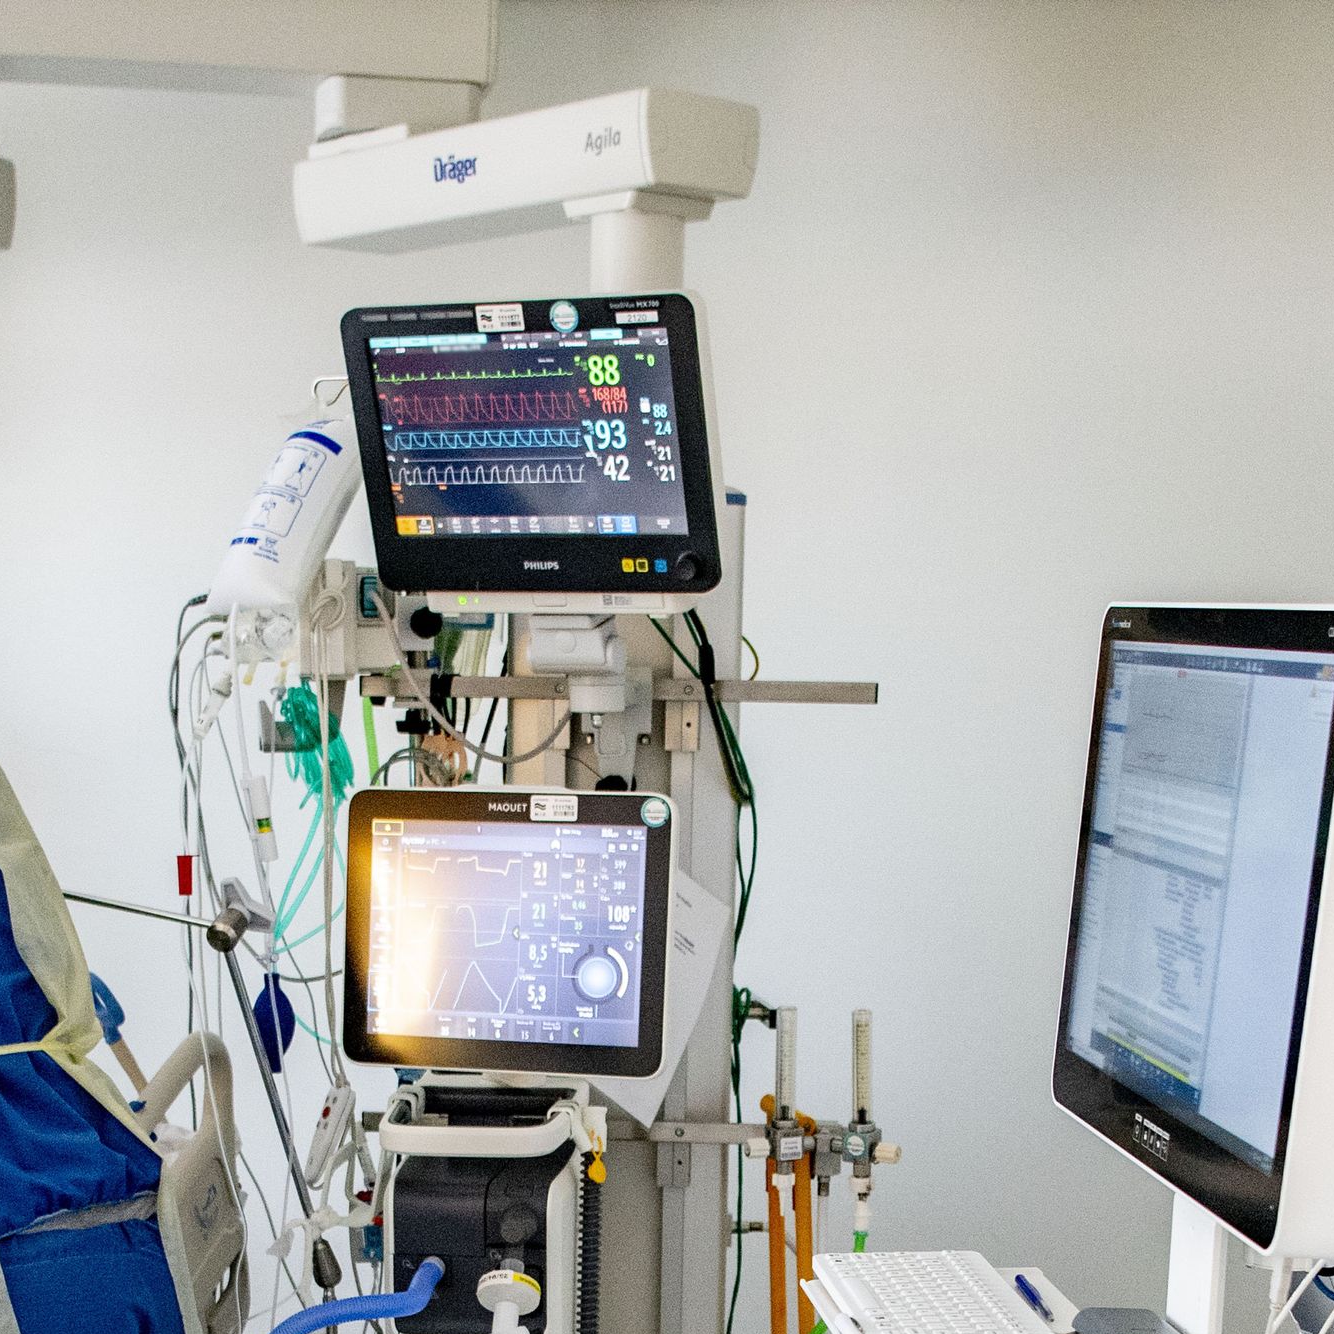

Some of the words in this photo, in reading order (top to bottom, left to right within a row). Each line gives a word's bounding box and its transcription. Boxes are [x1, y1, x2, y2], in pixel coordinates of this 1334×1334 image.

[433, 154, 478, 184] Dräger
[587, 353, 621, 386] 88
[652, 403, 668, 418] 88
[595, 419, 627, 449] 93
[657, 445, 672, 460] 21
[603, 454, 631, 481] 42
[659, 465, 676, 482] 21
[523, 560, 560, 571] PHILIPS
[533, 860, 547, 879] 21
[532, 902, 546, 920] 21
